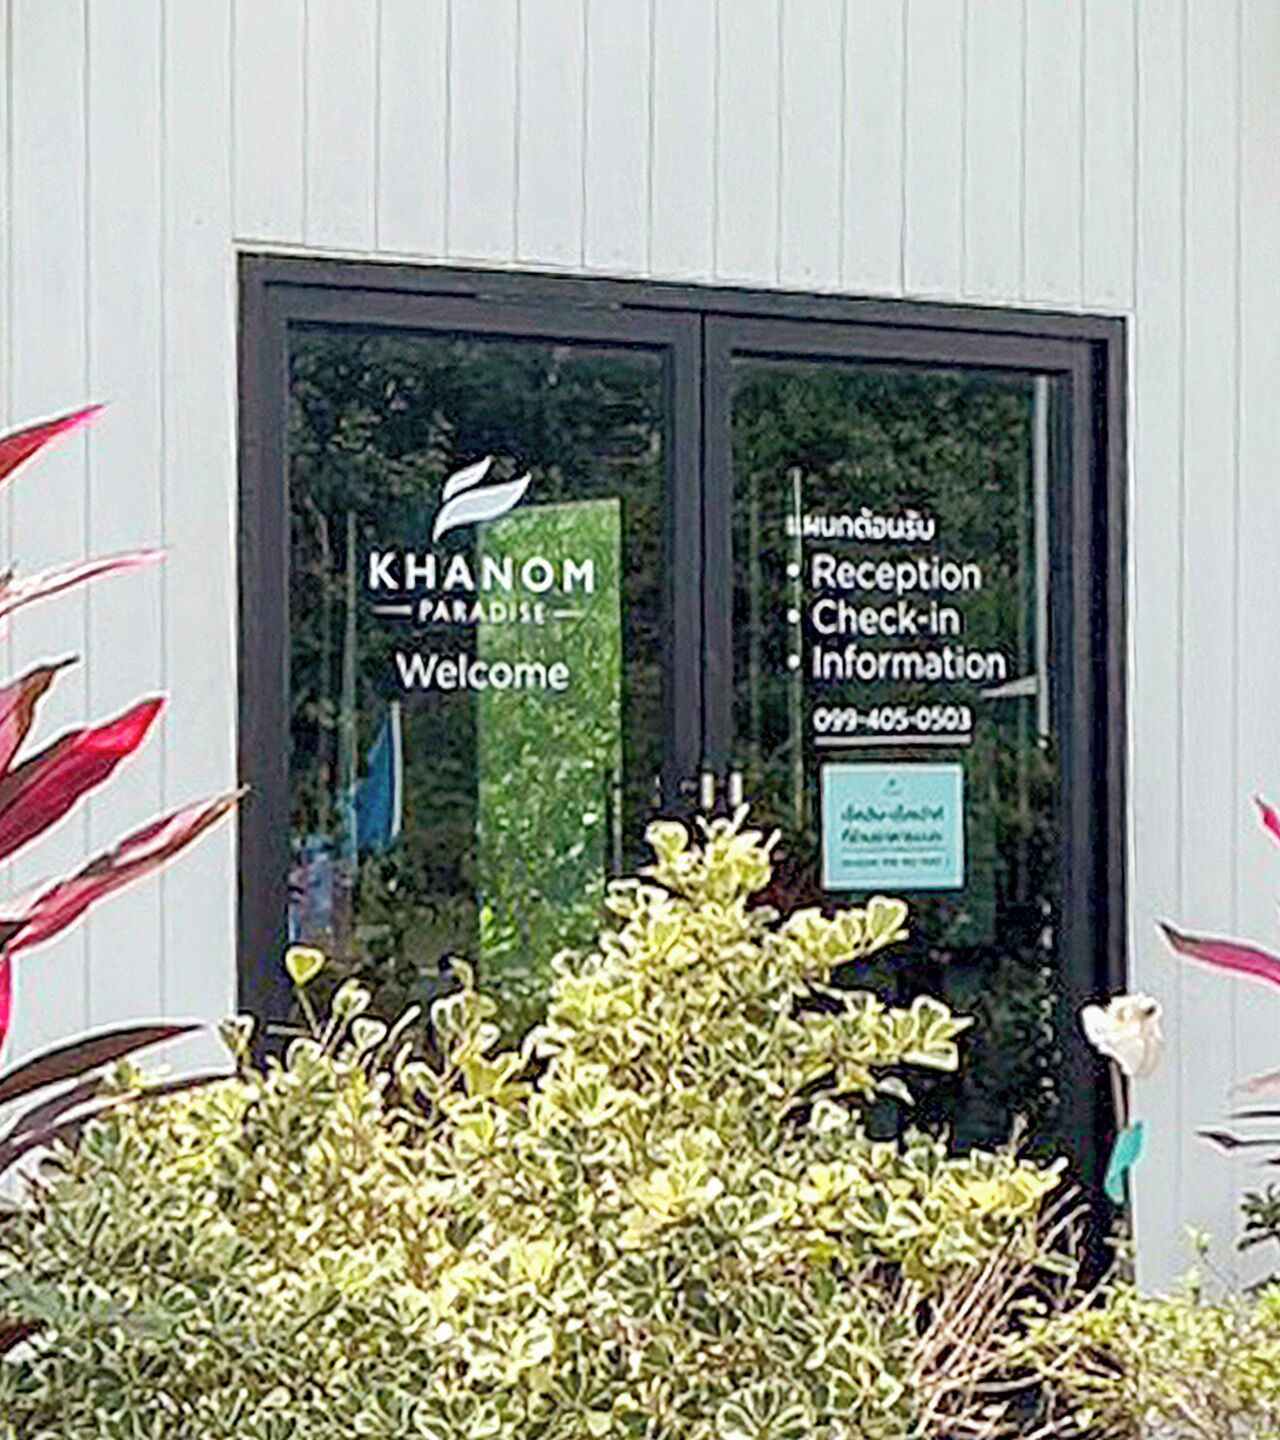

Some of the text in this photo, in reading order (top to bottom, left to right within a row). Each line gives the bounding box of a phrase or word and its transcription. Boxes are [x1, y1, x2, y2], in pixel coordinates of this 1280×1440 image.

[368, 551, 595, 594] KHANOM
[811, 553, 982, 595] Reception
[418, 599, 546, 625] PARADISE
[811, 598, 960, 635] Check-in
[396, 653, 570, 690] Welcome
[812, 644, 1007, 681] Information
[812, 706, 972, 732] 099-405-0503
